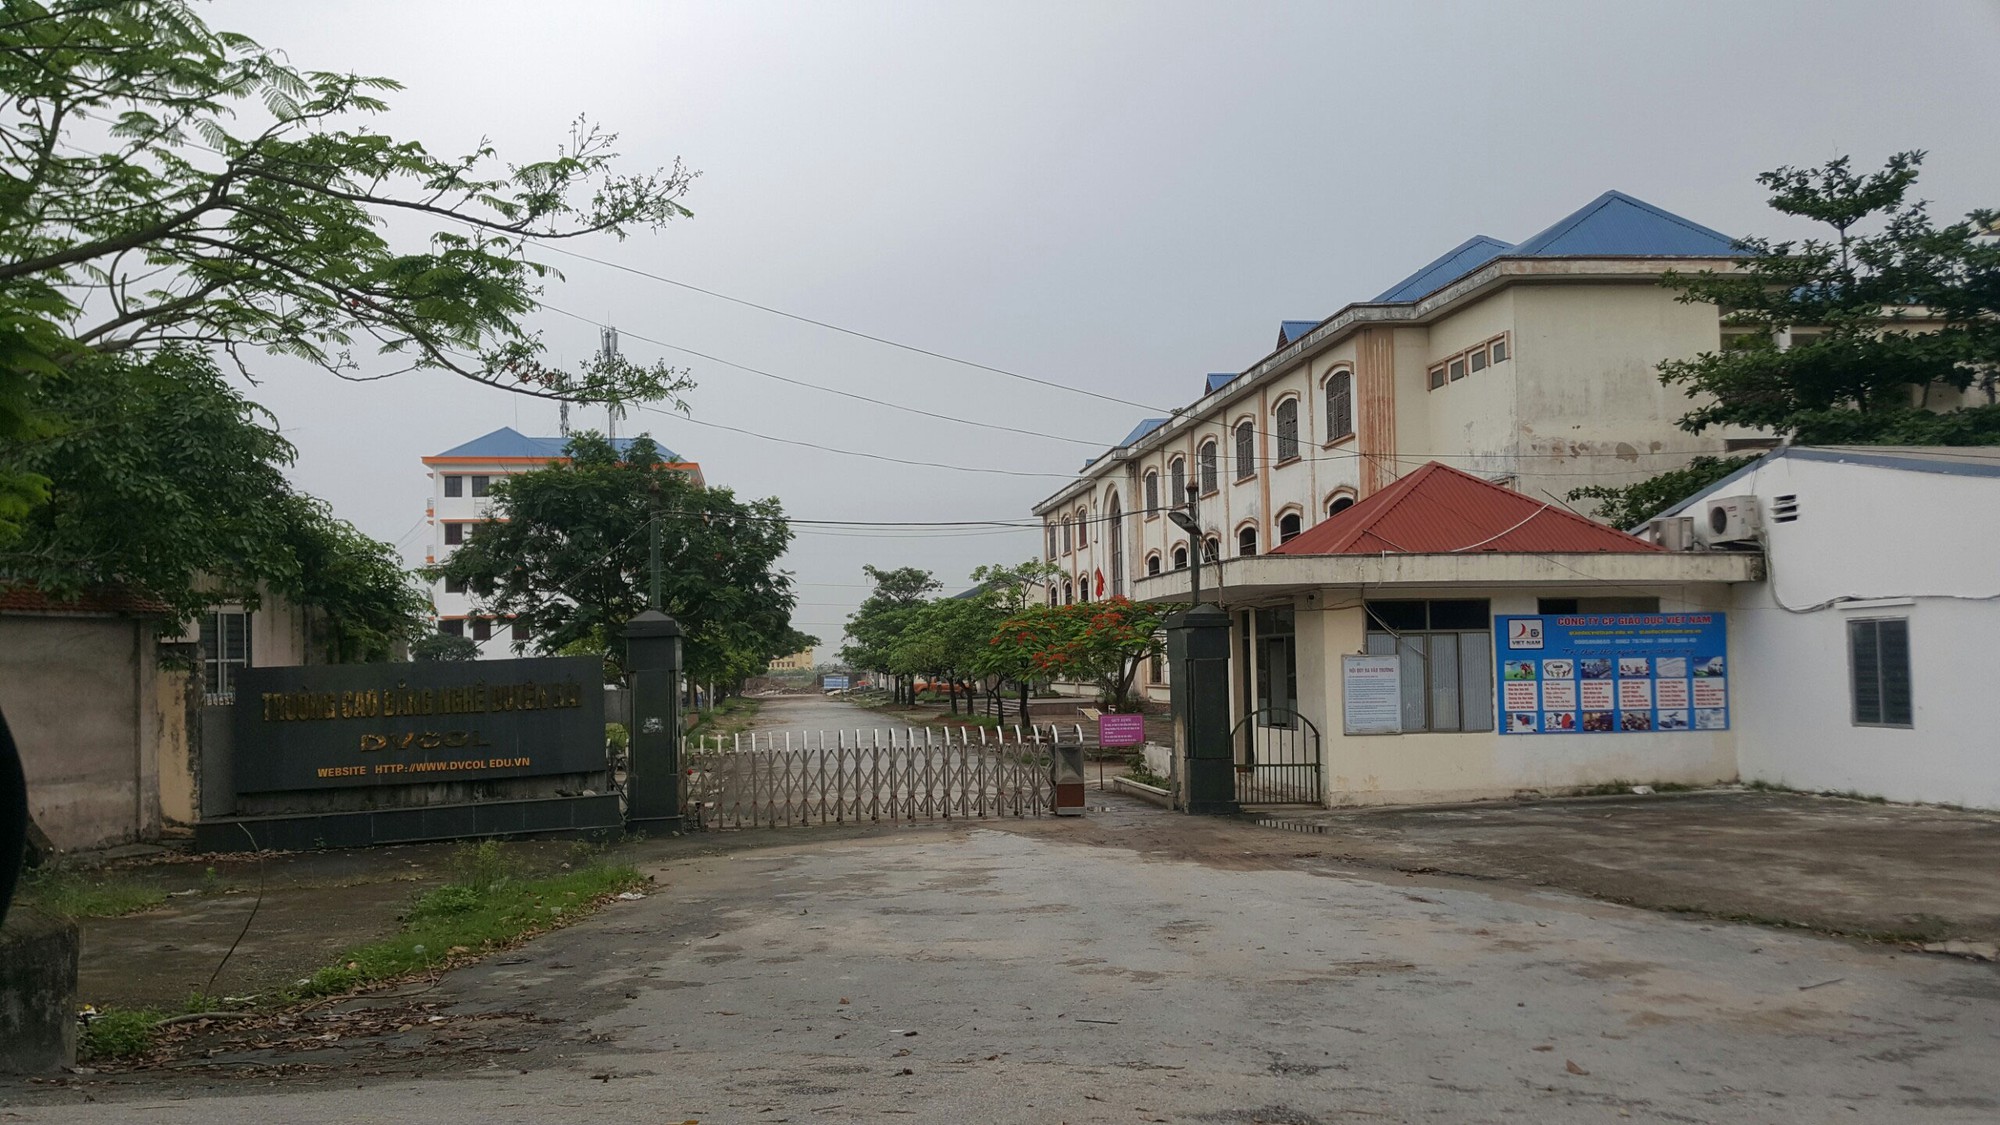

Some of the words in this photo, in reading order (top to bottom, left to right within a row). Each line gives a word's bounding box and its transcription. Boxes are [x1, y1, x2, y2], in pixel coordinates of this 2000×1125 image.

[1588, 617, 1599, 625] TY
[1602, 616, 1615, 625] CP
[1688, 615, 1712, 624] NAM
[341, 688, 379, 719] CAO
[360, 729, 491, 752] DVCOL
[317, 765, 367, 778] WEBSITE
